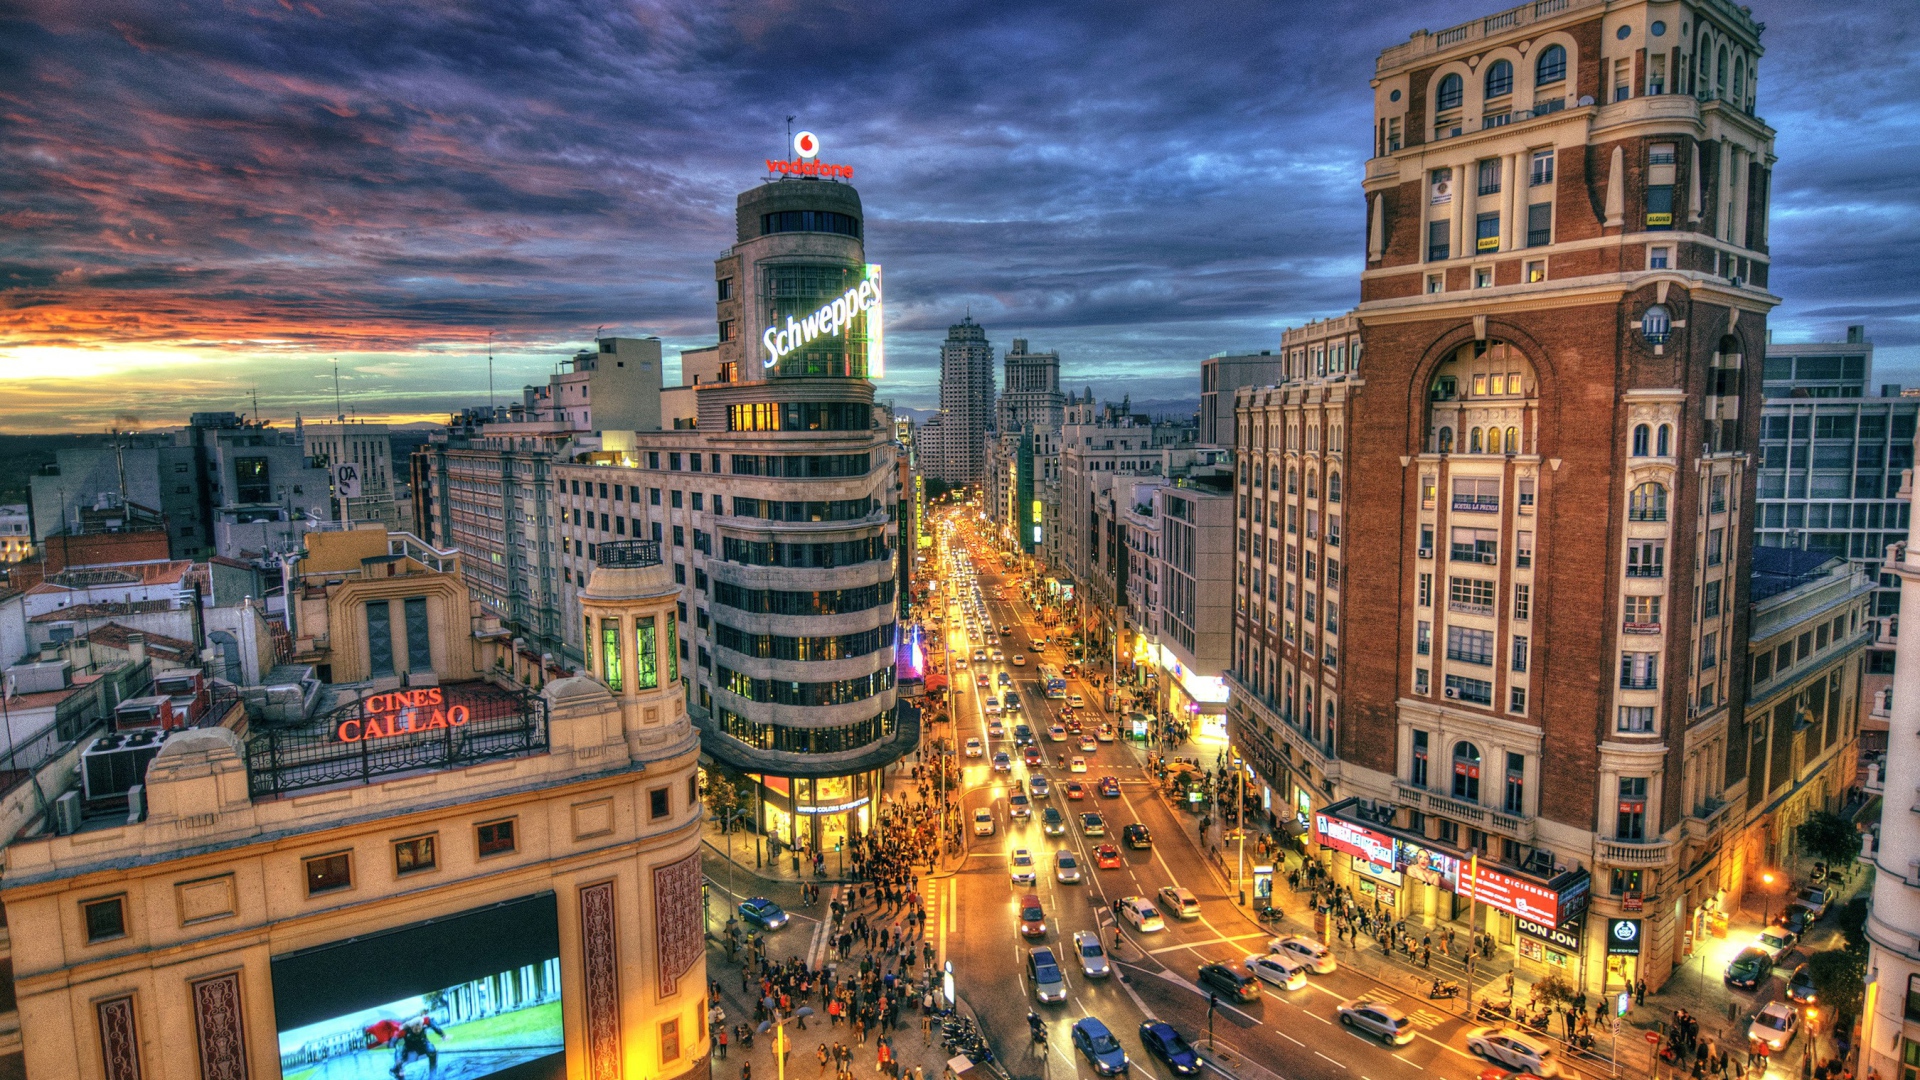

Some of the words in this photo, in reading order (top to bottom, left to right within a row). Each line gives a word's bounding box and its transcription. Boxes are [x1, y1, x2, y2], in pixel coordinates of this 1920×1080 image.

[765, 158, 854, 179] vodafone
[763, 273, 882, 369] Schweppes
[366, 687, 443, 715] CINES
[338, 705, 470, 743] CALLAO
[817, 805, 840, 813] COLORS
[1489, 873, 1501, 881] DE
[1504, 878, 1555, 900] DICIEMBRE
[1518, 918, 1548, 938] DON
[1549, 930, 1577, 948] JON
[1406, 1009, 1446, 1031] BUS
